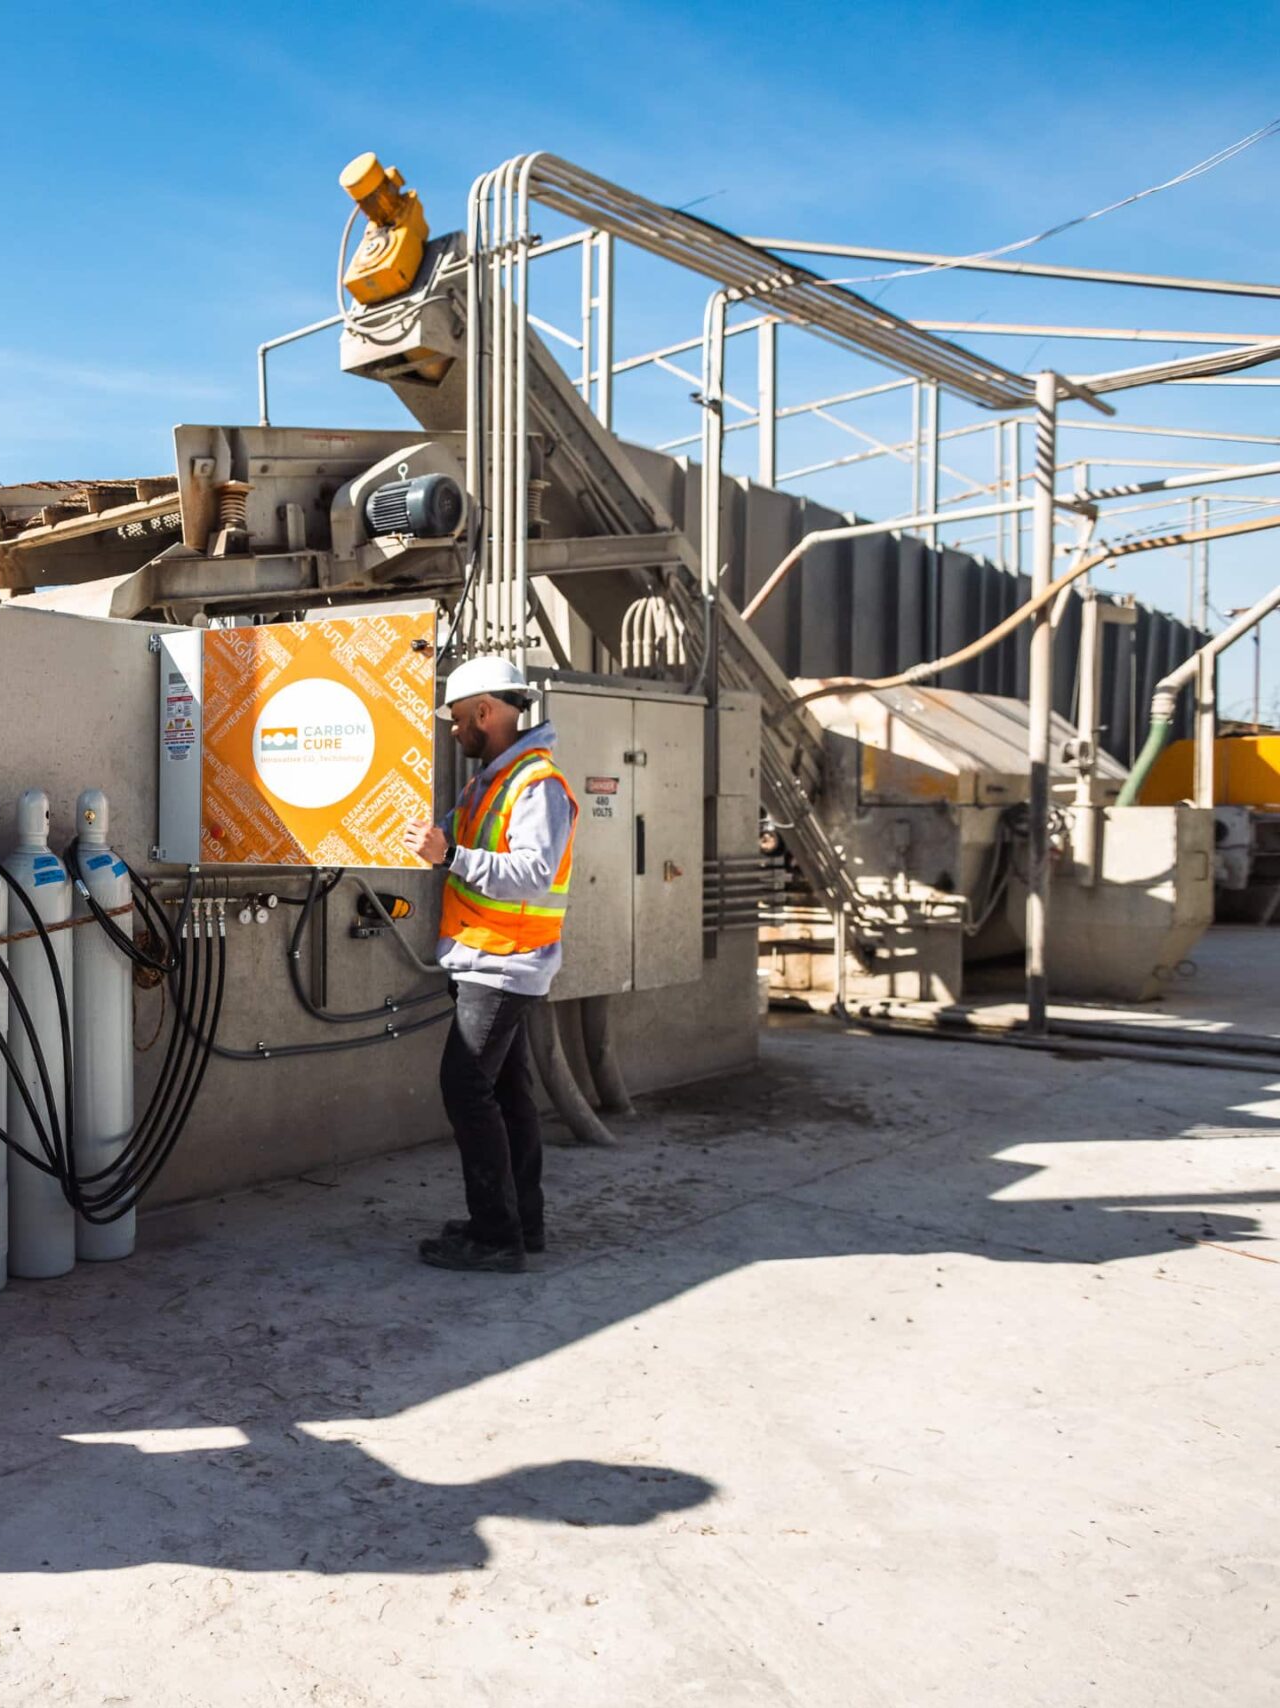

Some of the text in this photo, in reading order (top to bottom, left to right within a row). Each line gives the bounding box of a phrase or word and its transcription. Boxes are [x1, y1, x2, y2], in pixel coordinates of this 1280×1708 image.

[318, 621, 360, 662] FUTURE
[226, 690, 261, 729] HEALTHY
[389, 676, 432, 720] DESIGN
[303, 738, 342, 750] CURE
[304, 724, 366, 737] CARBON
[340, 801, 366, 827] CLEAN
[352, 779, 400, 828] INNOVATION
[592, 808, 612, 817] VOLTS
[596, 796, 609, 805] 480
[207, 796, 245, 842] INNOVATION
[257, 804, 311, 857] INNOVATION
[346, 824, 378, 856] UPCYCLE
